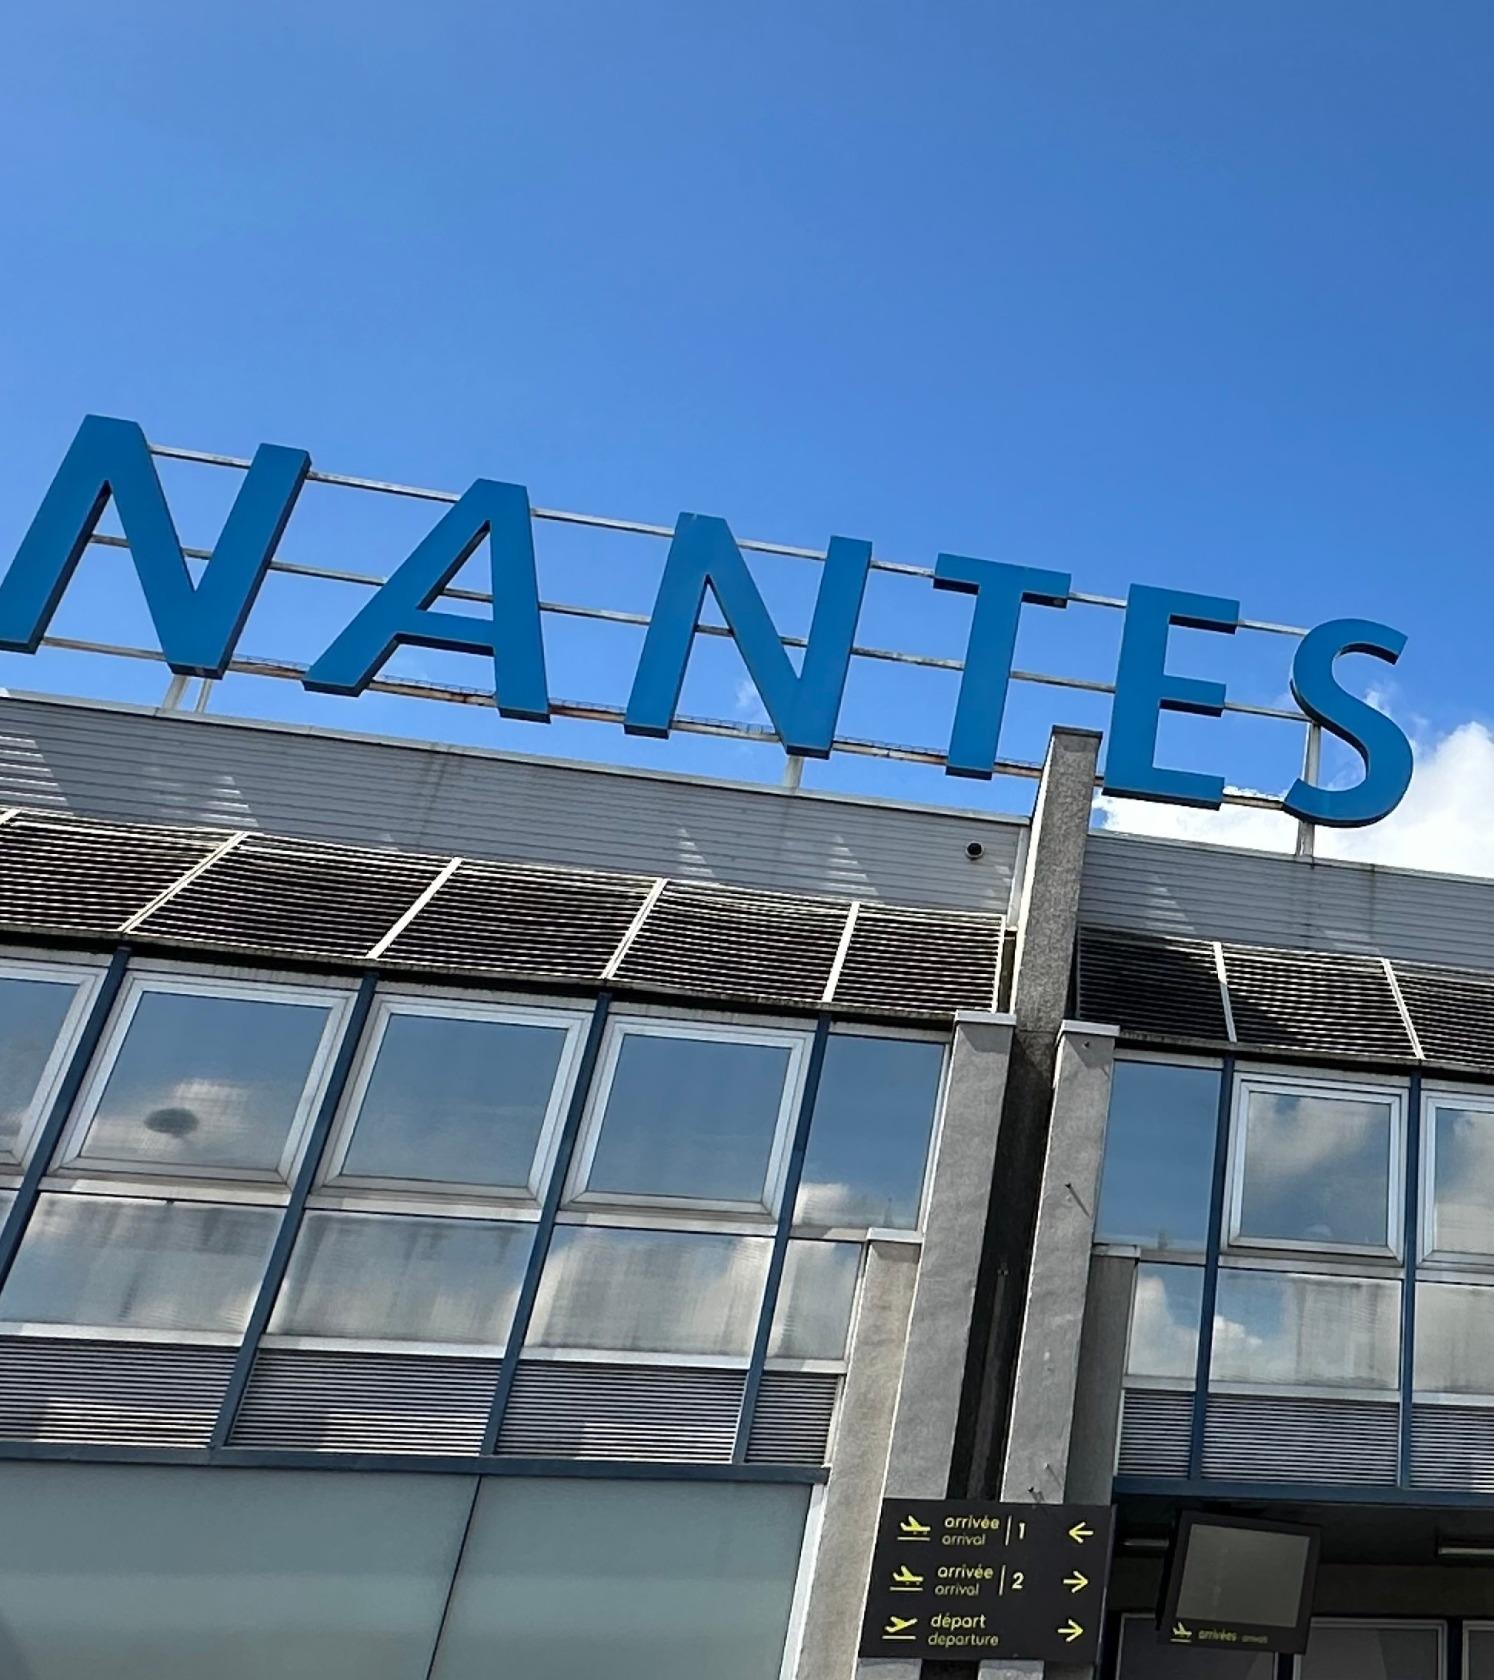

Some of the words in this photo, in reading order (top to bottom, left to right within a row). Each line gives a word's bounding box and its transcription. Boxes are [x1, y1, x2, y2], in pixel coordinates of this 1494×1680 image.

[0, 413, 1413, 829] NANTES
[944, 1514, 1000, 1529] arrivée
[1018, 1522, 1026, 1539] 1
[941, 1533, 986, 1546] arrival
[937, 1563, 994, 1580] arrivée
[1011, 1572, 1025, 1590] 2
[934, 1583, 980, 1596] arrival
[930, 1613, 986, 1631] départ
[927, 1632, 999, 1648] departure
